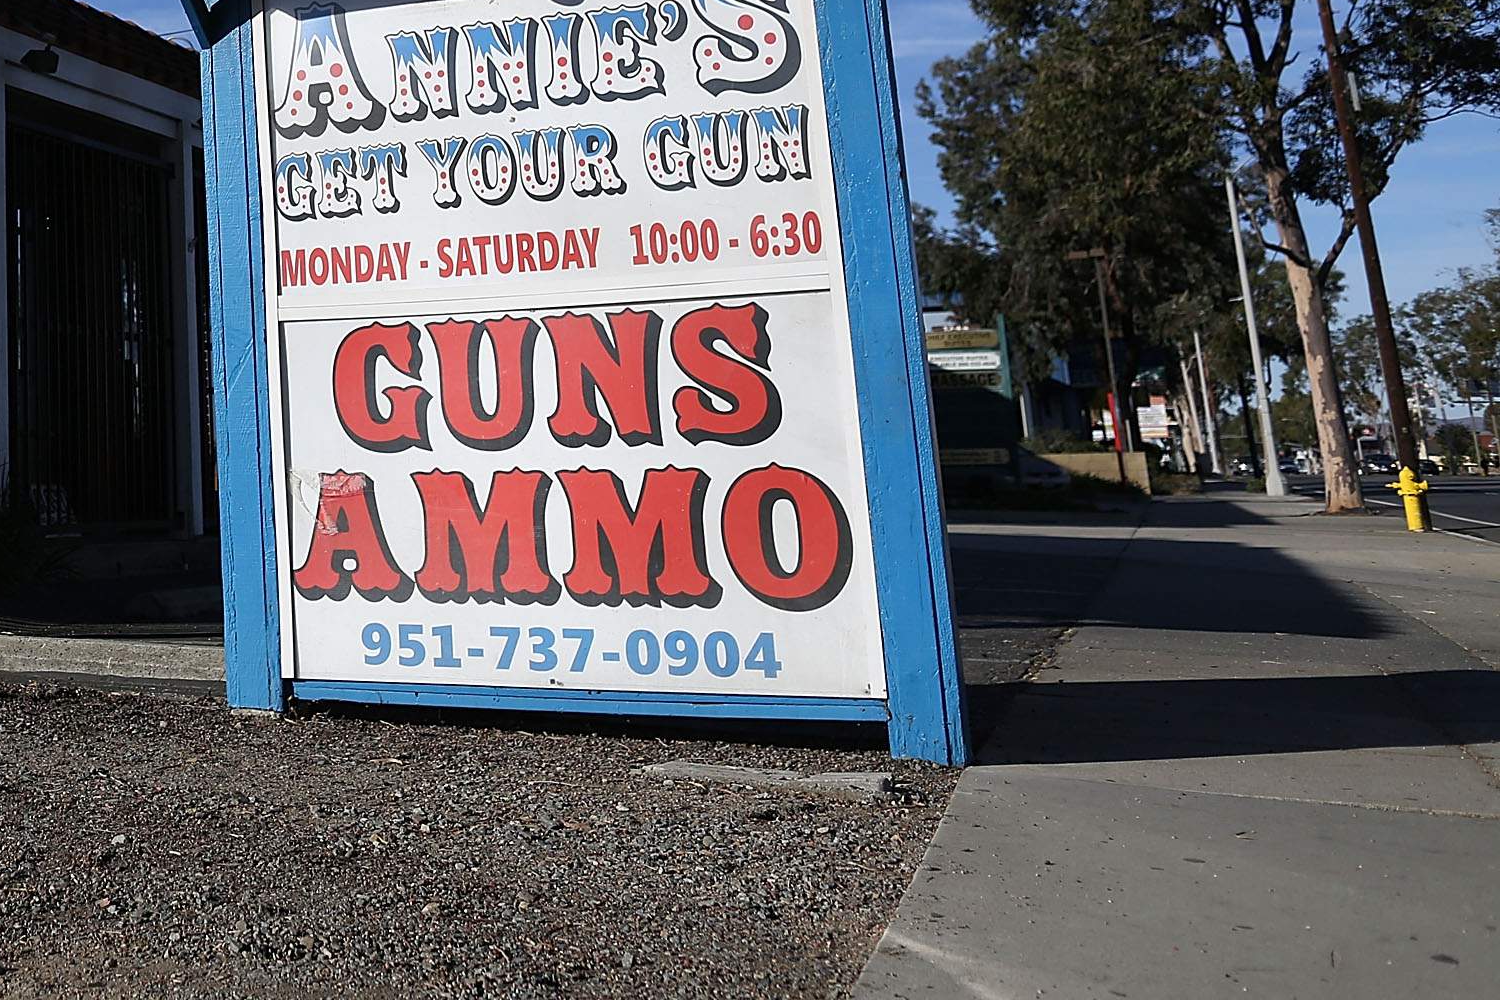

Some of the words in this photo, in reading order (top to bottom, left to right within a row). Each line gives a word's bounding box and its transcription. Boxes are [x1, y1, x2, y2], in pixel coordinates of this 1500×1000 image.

[275, 143, 407, 221] GET
[416, 123, 627, 206] YOUR
[643, 103, 811, 191] GUN
[281, 241, 411, 287] MONDAY
[438, 227, 601, 277] SATURDAY
[629, 219, 720, 266] 10:00
[748, 211, 823, 257] 6:30
[333, 301, 782, 453] GUNS
[293, 461, 853, 612] AMMO
[360, 622, 782, 679] 951-737-0904
